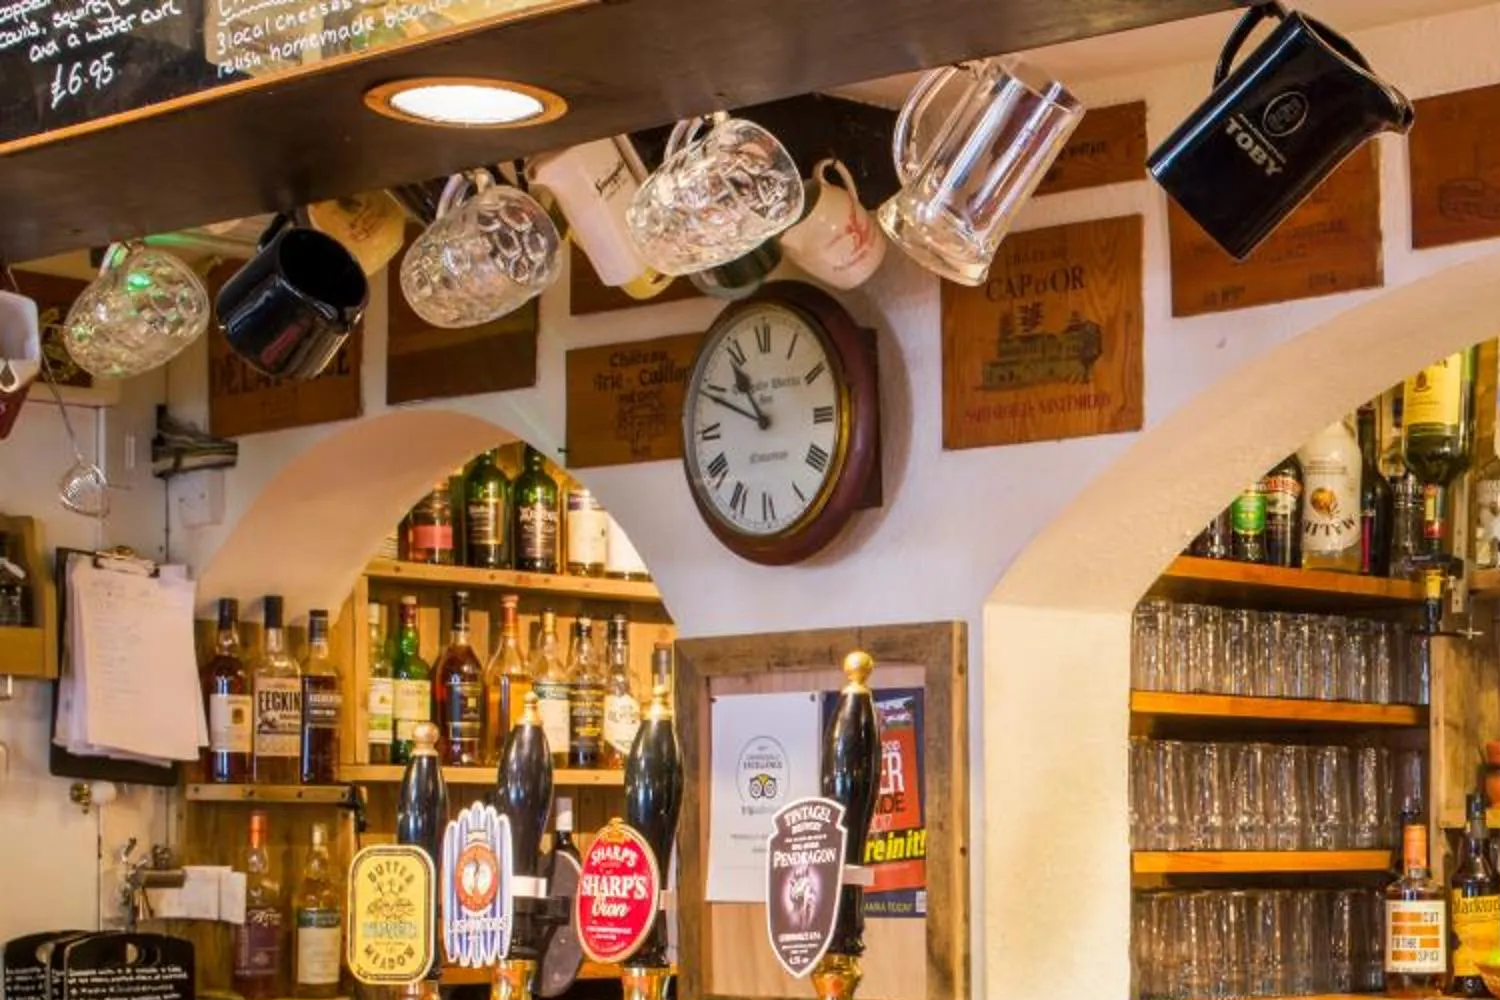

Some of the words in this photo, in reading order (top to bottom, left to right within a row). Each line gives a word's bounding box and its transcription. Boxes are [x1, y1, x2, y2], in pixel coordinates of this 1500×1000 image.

[270, 16, 376, 62] homemade
[1225, 117, 1284, 177] TOBY
[985, 274, 1033, 302] CAP
[591, 845, 639, 868] SHARP'S
[581, 873, 649, 900] SHARP'S
